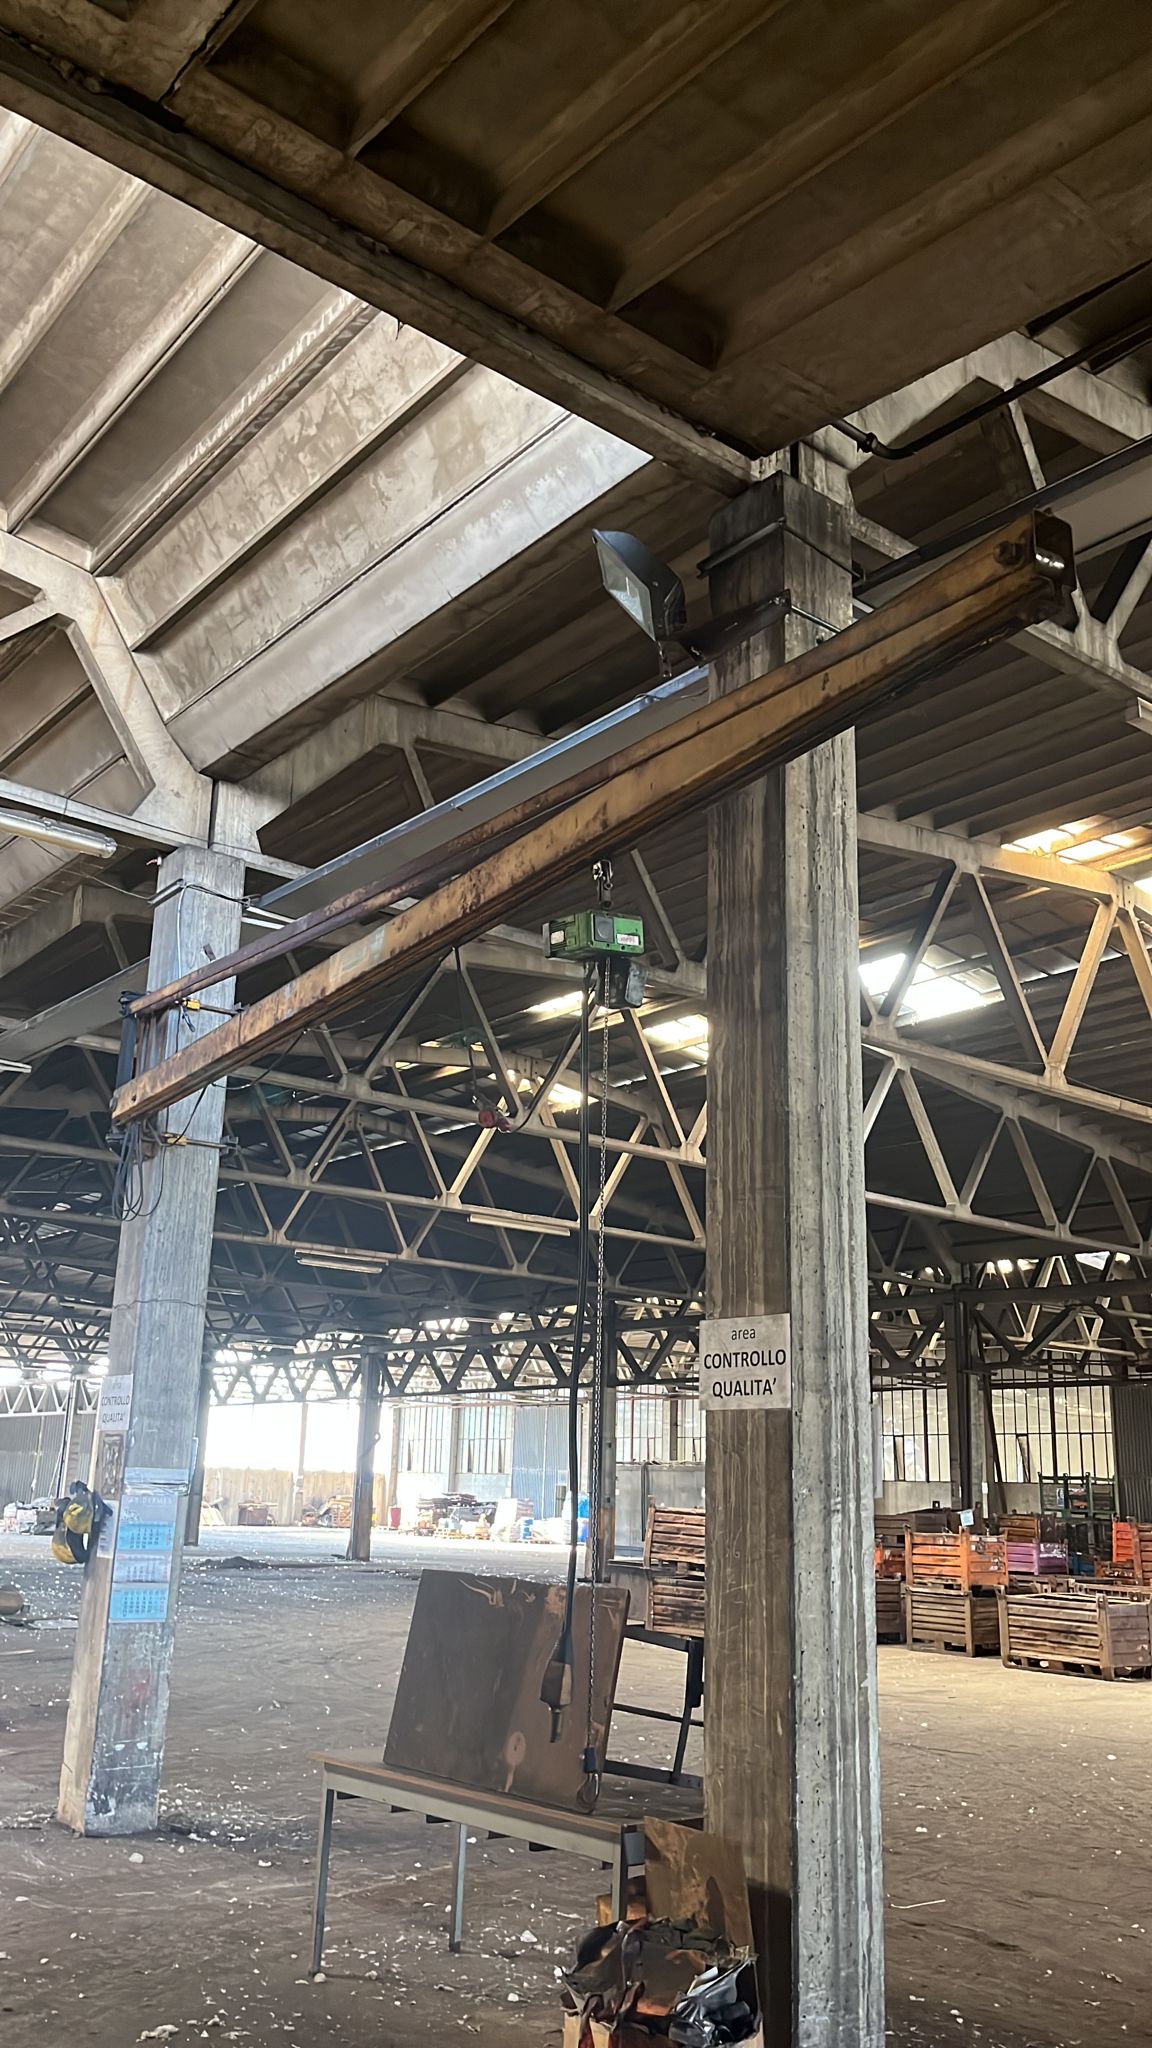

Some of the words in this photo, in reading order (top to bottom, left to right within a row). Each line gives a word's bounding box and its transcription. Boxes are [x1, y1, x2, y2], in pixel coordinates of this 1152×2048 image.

[731, 1328, 756, 1340] area
[703, 1349, 787, 1369] CONTROLLO
[102, 1394, 130, 1406] CONTROLLO
